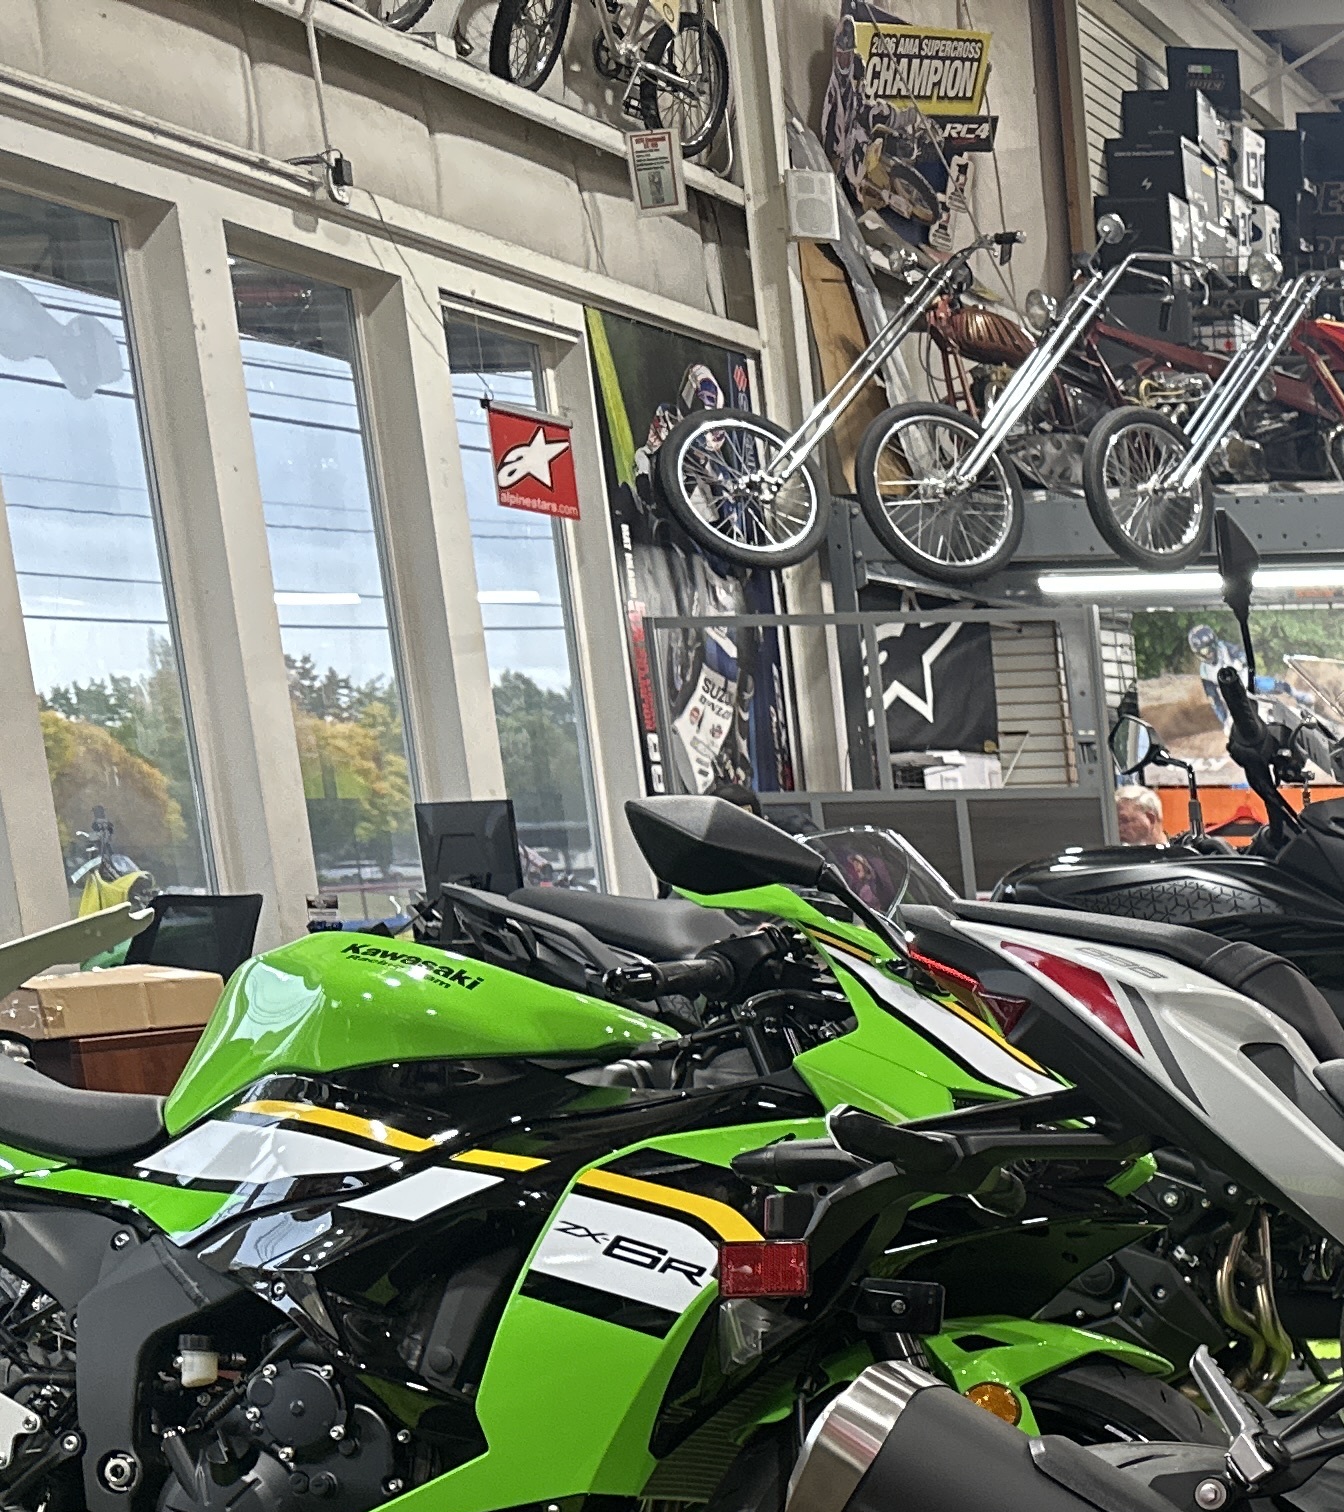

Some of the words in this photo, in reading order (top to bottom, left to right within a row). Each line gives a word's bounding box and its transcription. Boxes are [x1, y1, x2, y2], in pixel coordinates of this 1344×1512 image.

[897, 38, 920, 56] AMA
[921, 38, 983, 59] SUPERCROSS
[865, 56, 979, 98] CHAMPION
[942, 123, 990, 139] RC4
[500, 491, 579, 517] alpinestars.com
[340, 943, 485, 991] Kawasaki
[553, 1220, 707, 1288] ZX-6R
